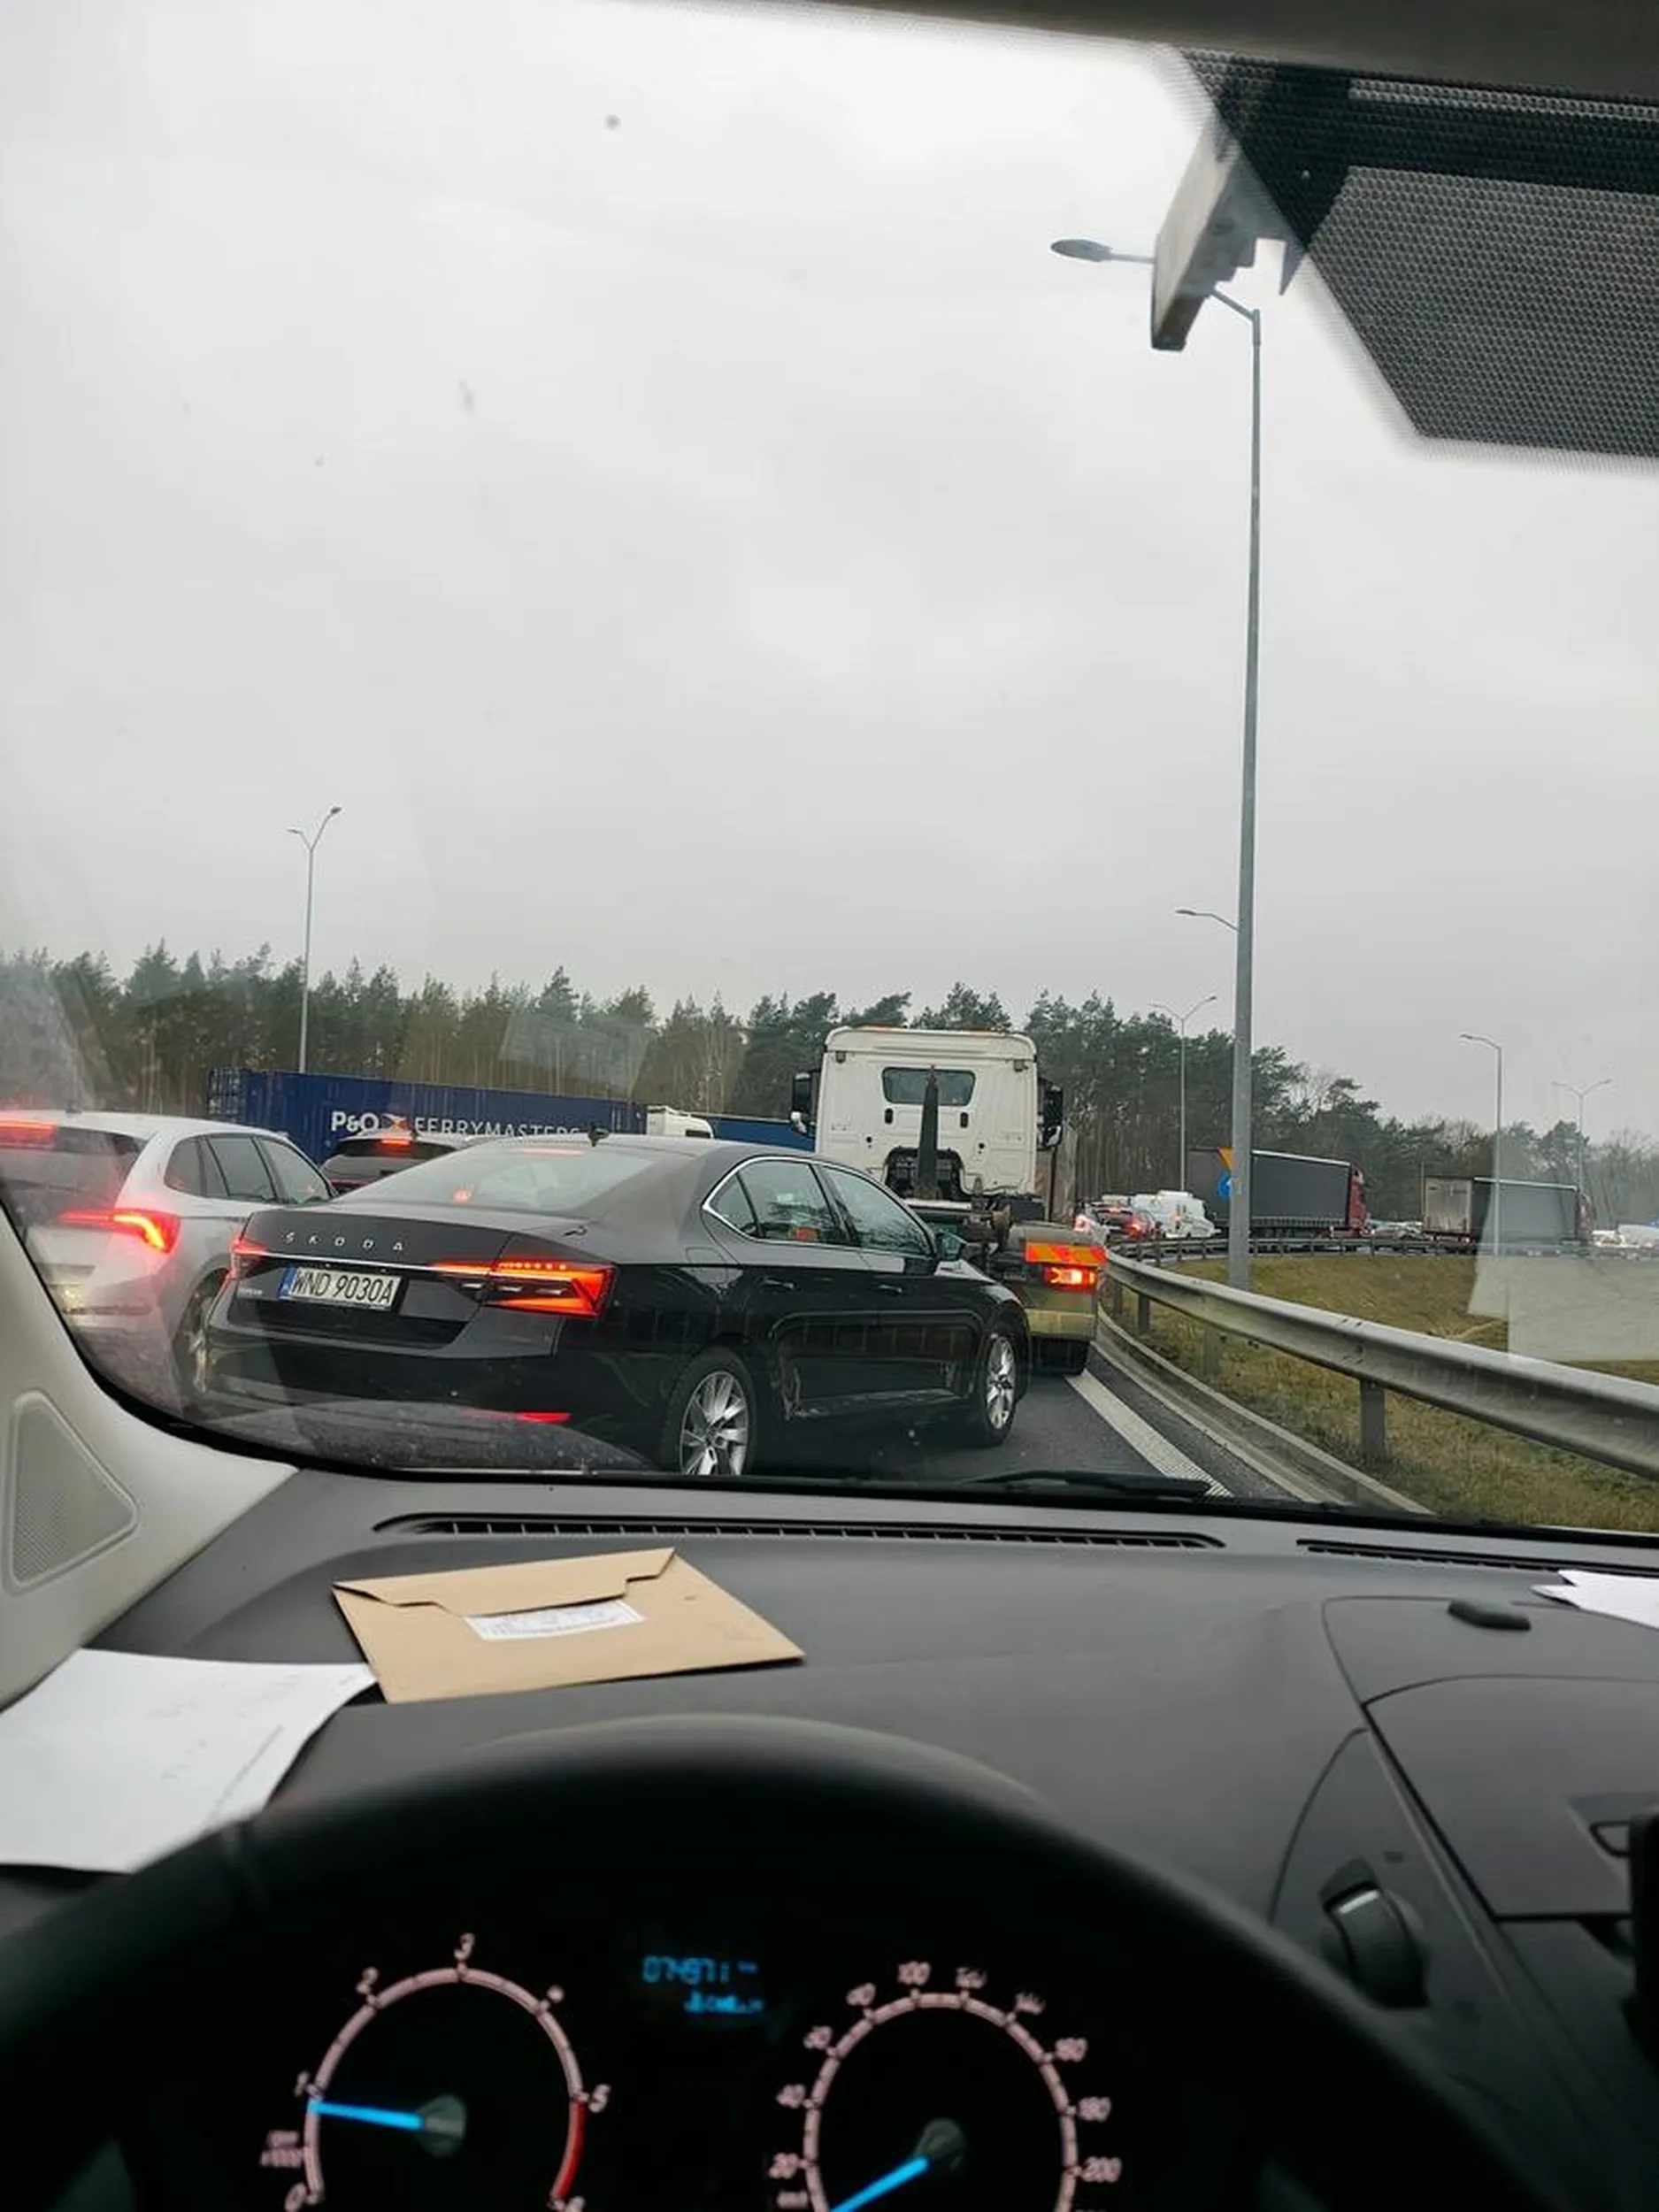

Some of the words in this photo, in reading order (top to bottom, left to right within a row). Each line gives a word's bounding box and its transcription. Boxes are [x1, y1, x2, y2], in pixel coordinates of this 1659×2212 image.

[331, 1111, 380, 1133] P&O
[293, 1271, 331, 1297] WND
[333, 1275, 394, 1303] 9030A
